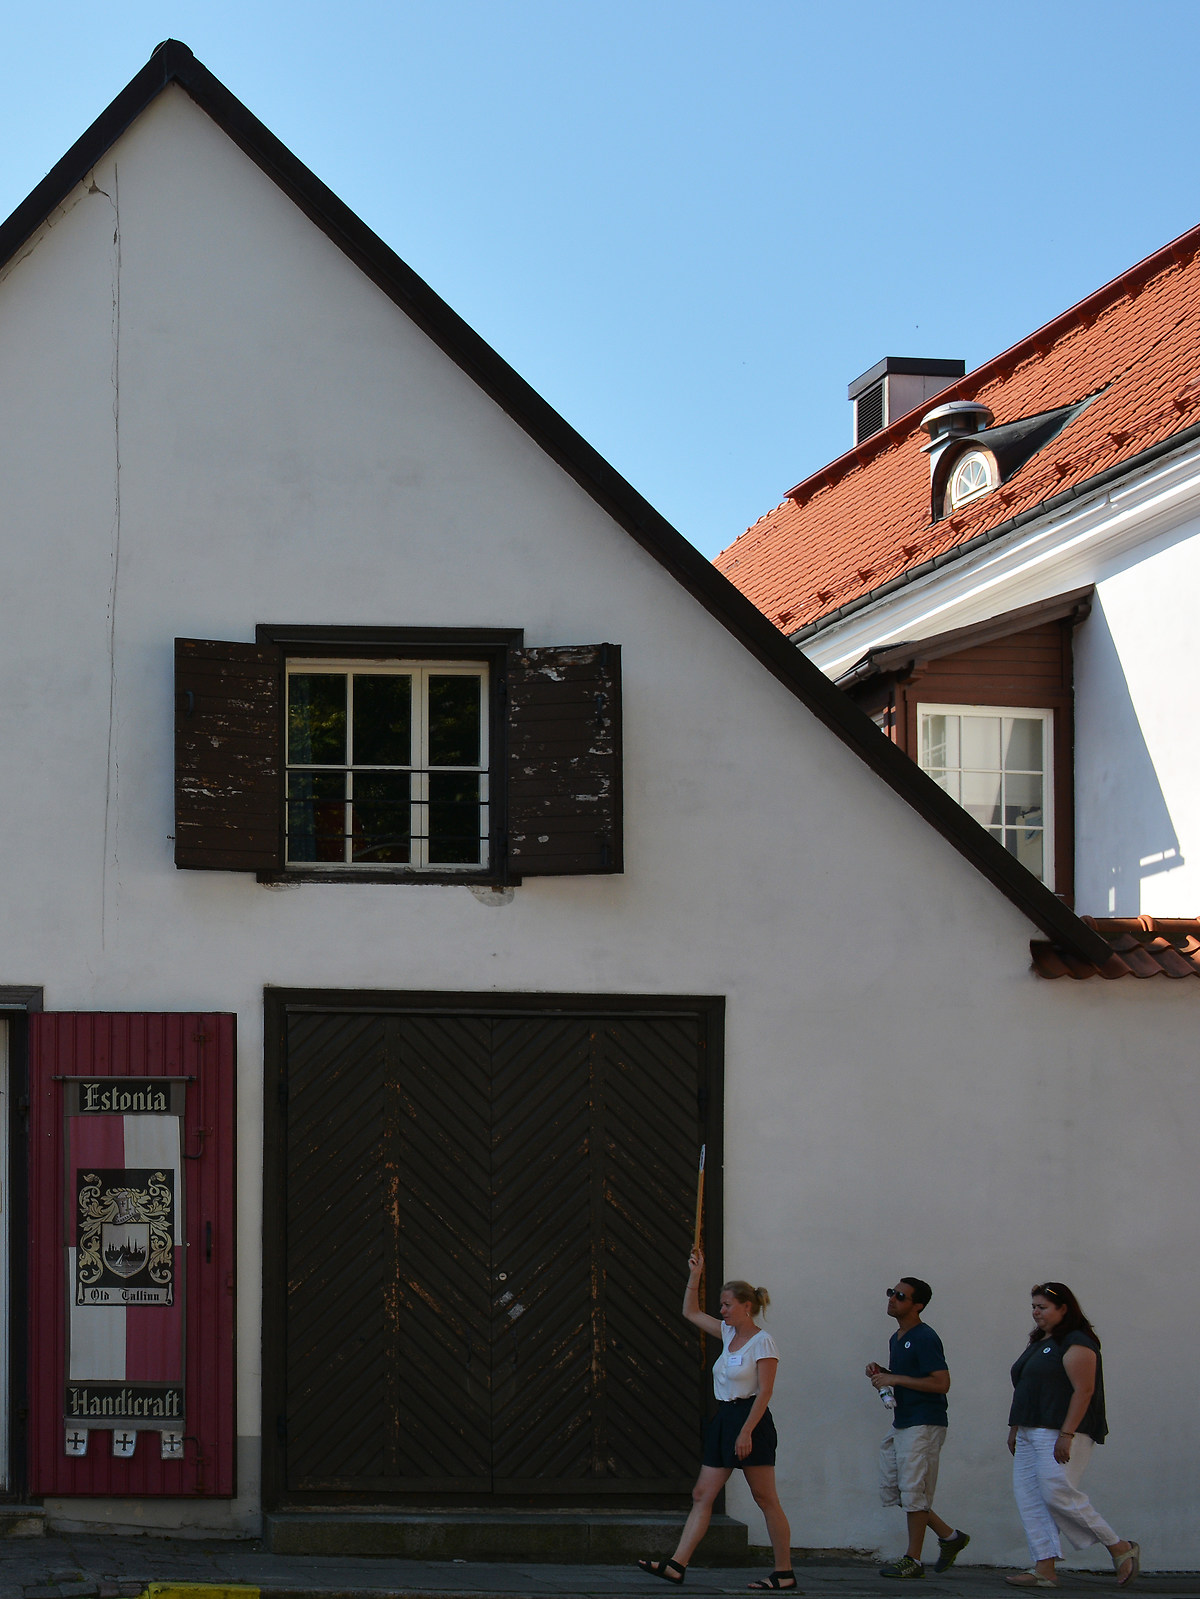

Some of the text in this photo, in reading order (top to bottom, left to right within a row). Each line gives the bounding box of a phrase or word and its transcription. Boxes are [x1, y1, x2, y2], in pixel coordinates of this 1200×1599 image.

[83, 1083, 167, 1111] Estonia
[90, 1288, 160, 1302] Old Tallinn
[69, 1387, 180, 1417] Handicraft
